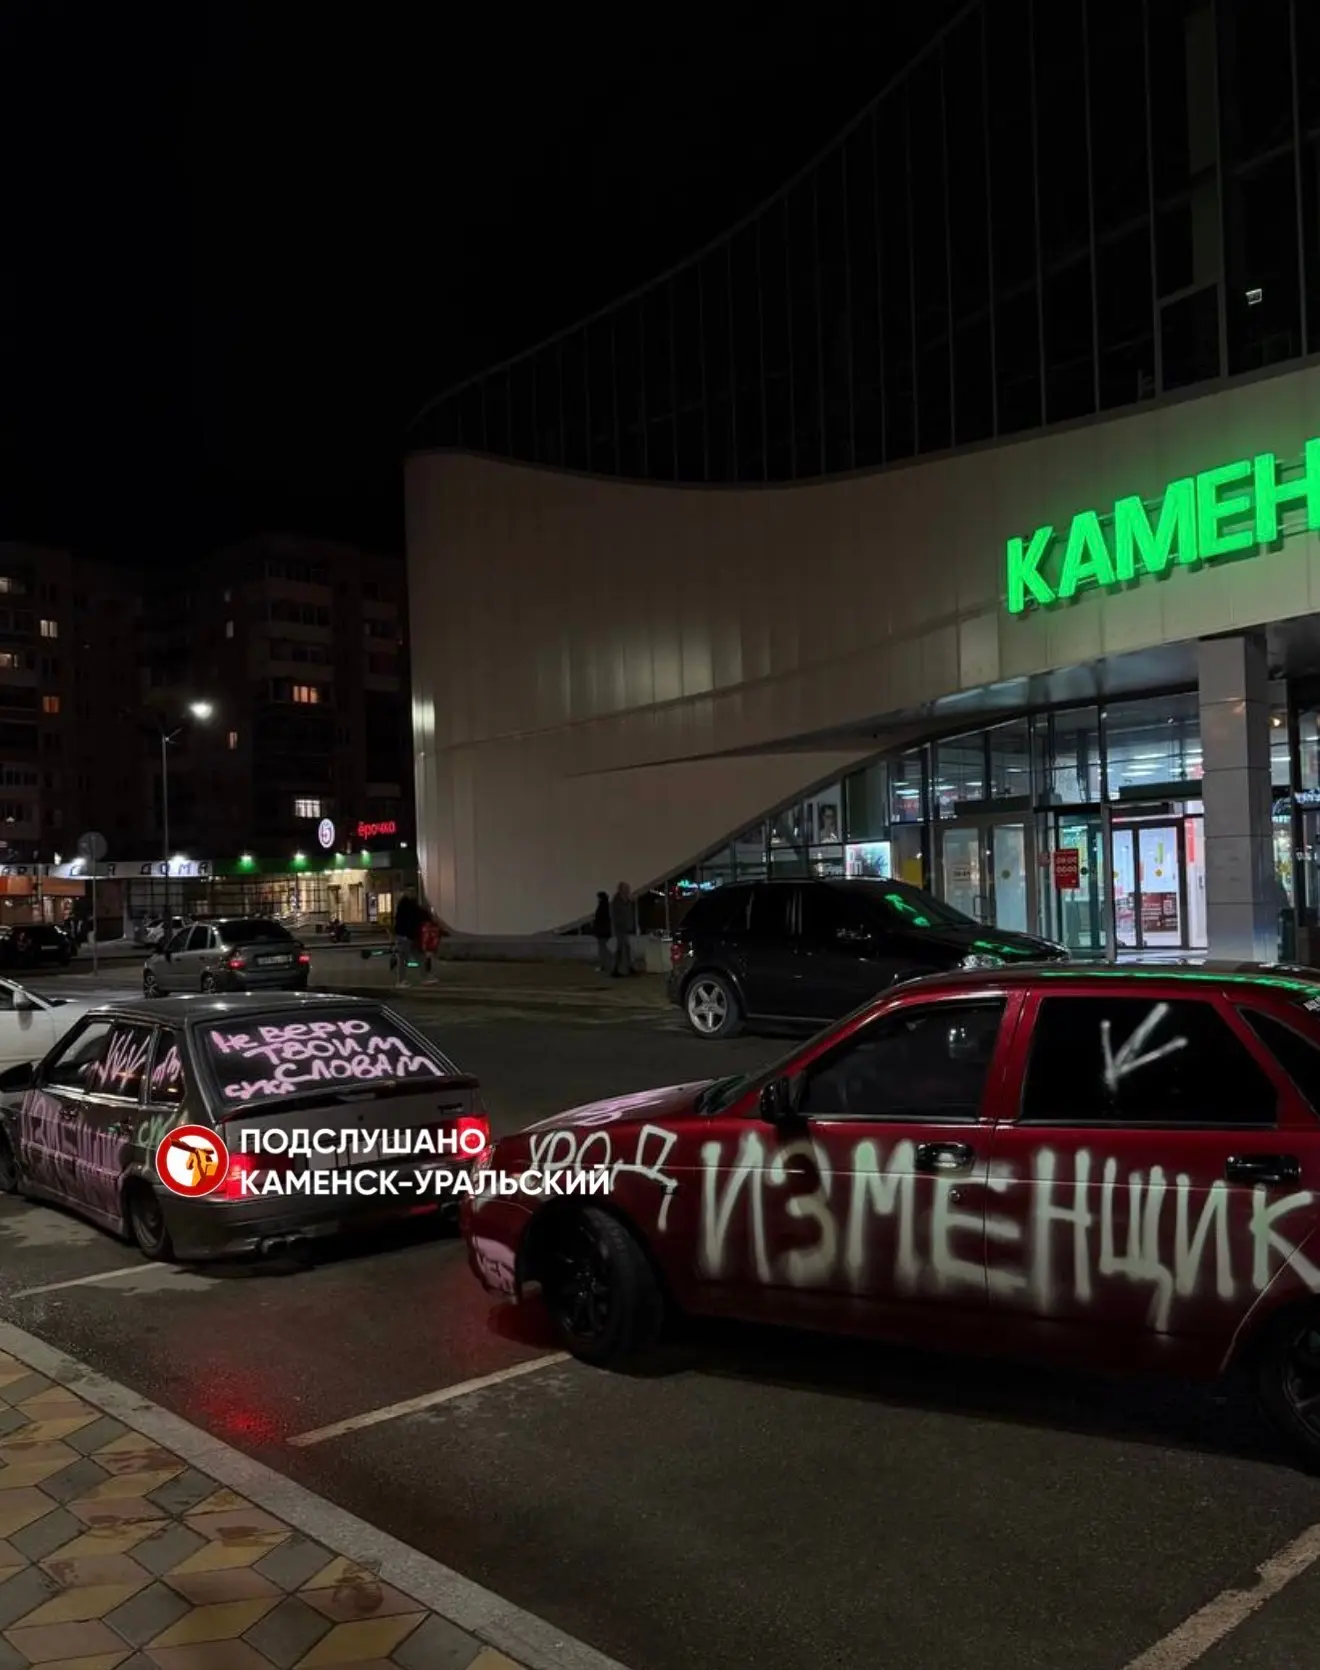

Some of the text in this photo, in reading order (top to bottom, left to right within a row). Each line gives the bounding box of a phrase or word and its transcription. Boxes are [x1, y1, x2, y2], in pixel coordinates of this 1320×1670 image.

[243, 1036, 413, 1065] ТВОИМ
[273, 1054, 446, 1083] СЛОВАМ
[701, 1128, 1320, 1335] ИЗМЕНЩИК
